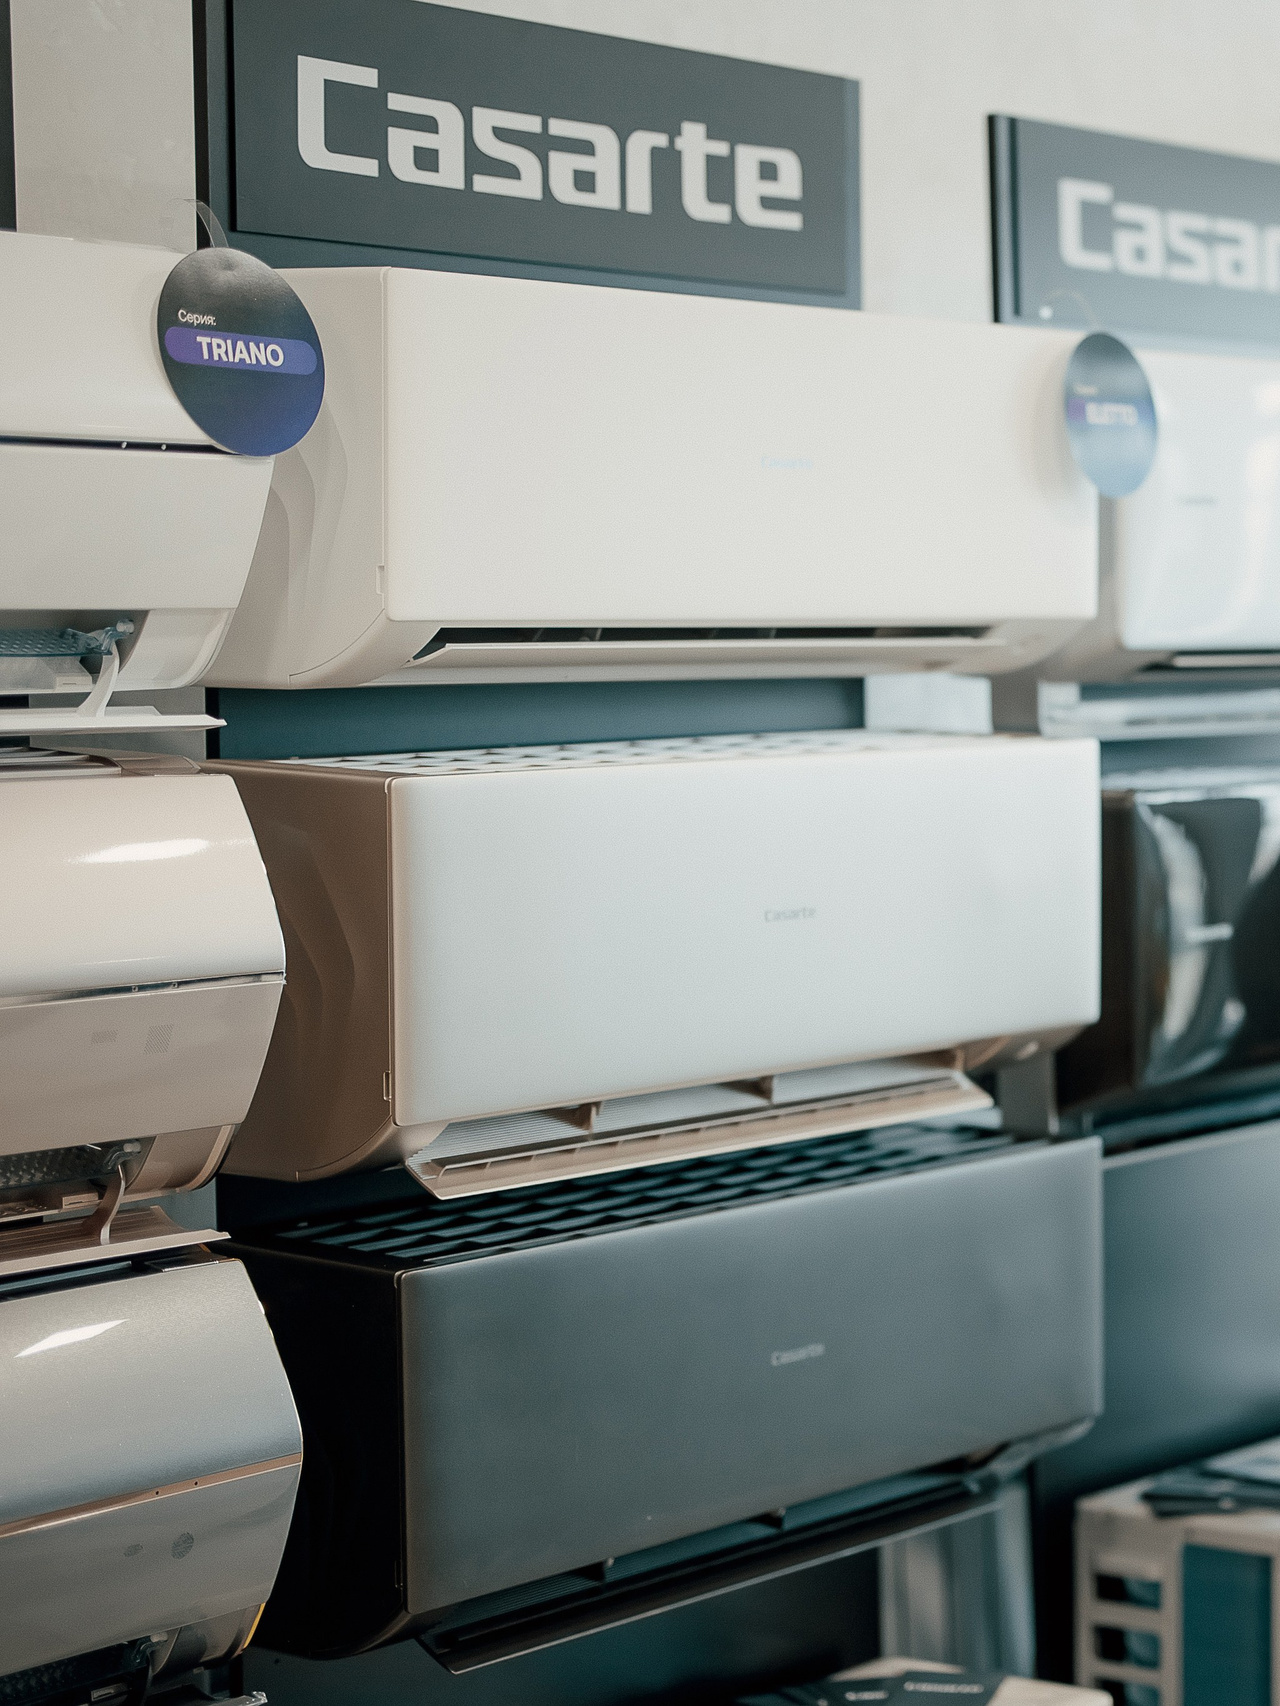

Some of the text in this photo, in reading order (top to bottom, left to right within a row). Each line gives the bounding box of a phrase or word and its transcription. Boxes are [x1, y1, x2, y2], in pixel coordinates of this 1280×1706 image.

[297, 55, 803, 231] Casarte
[177, 309, 217, 326] Серия:
[196, 336, 285, 367] TRIANO
